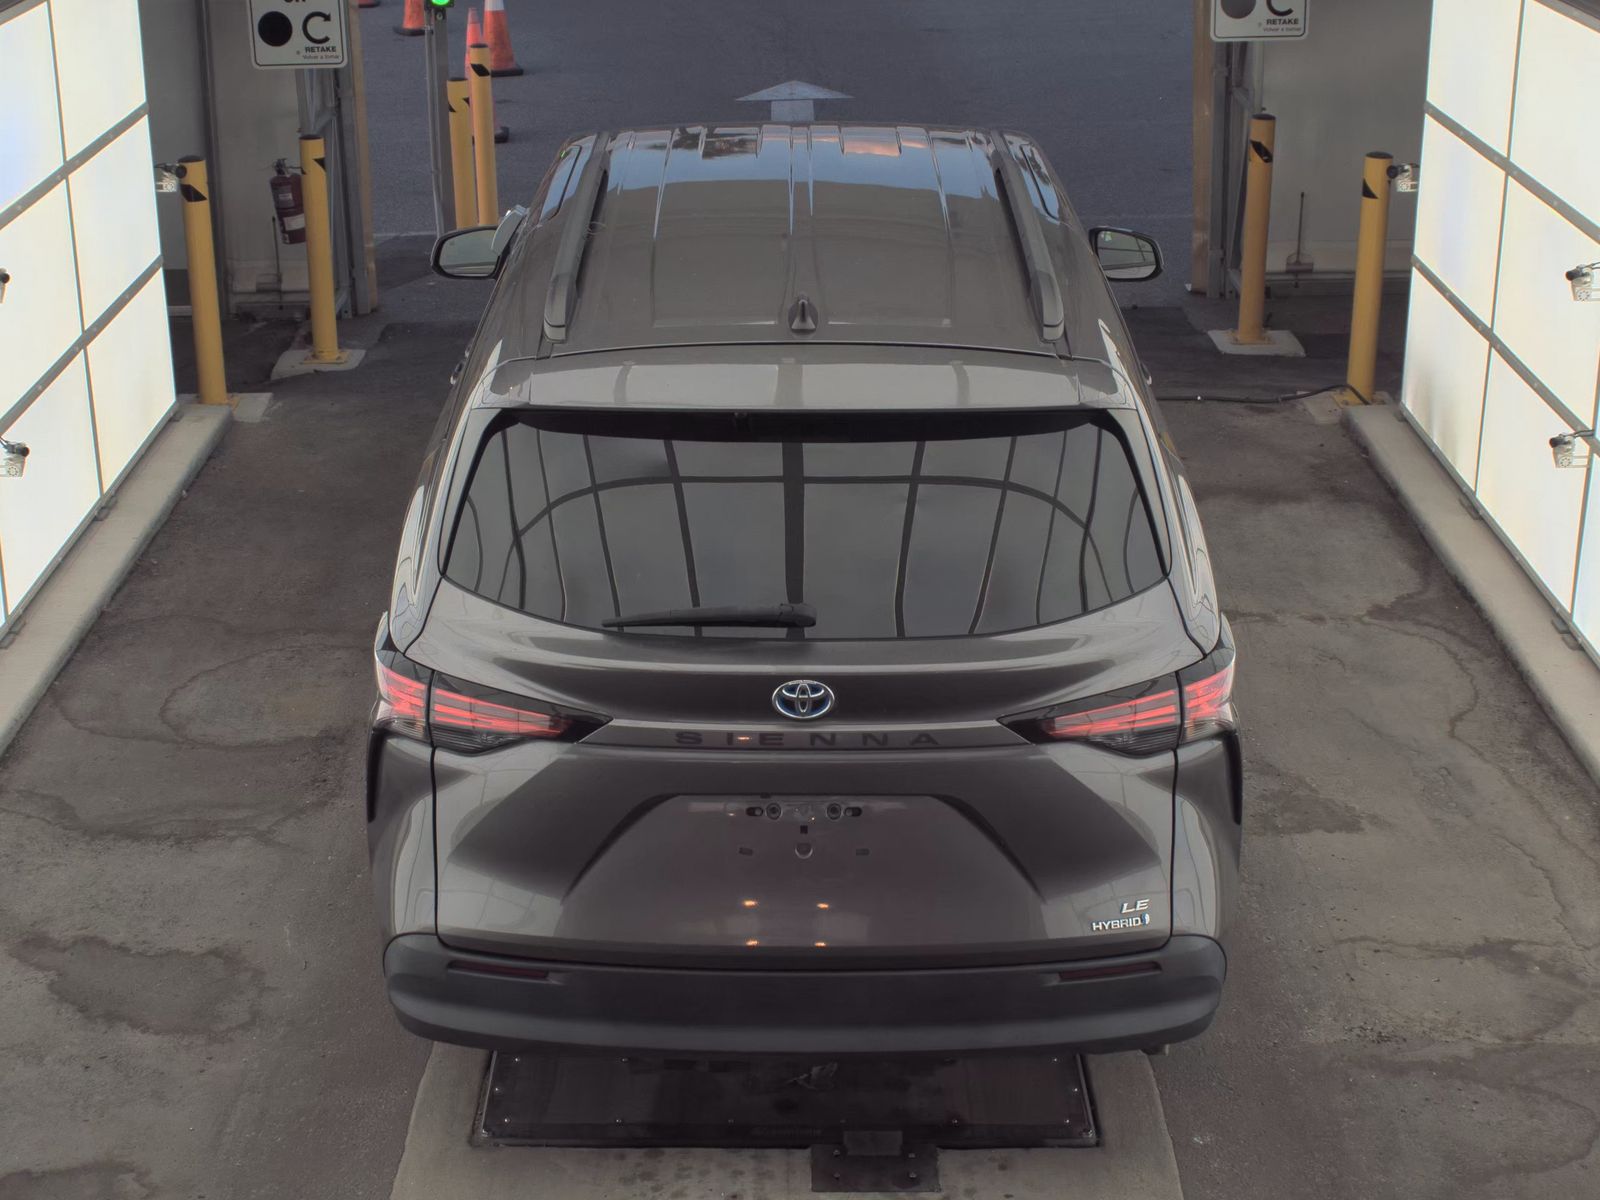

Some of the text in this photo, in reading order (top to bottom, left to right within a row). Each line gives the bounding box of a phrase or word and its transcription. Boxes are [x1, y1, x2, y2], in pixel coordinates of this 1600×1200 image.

[674, 732, 939, 746] SIENNA
[1121, 898, 1150, 913] LE
[1092, 917, 1141, 931] HYBRID
